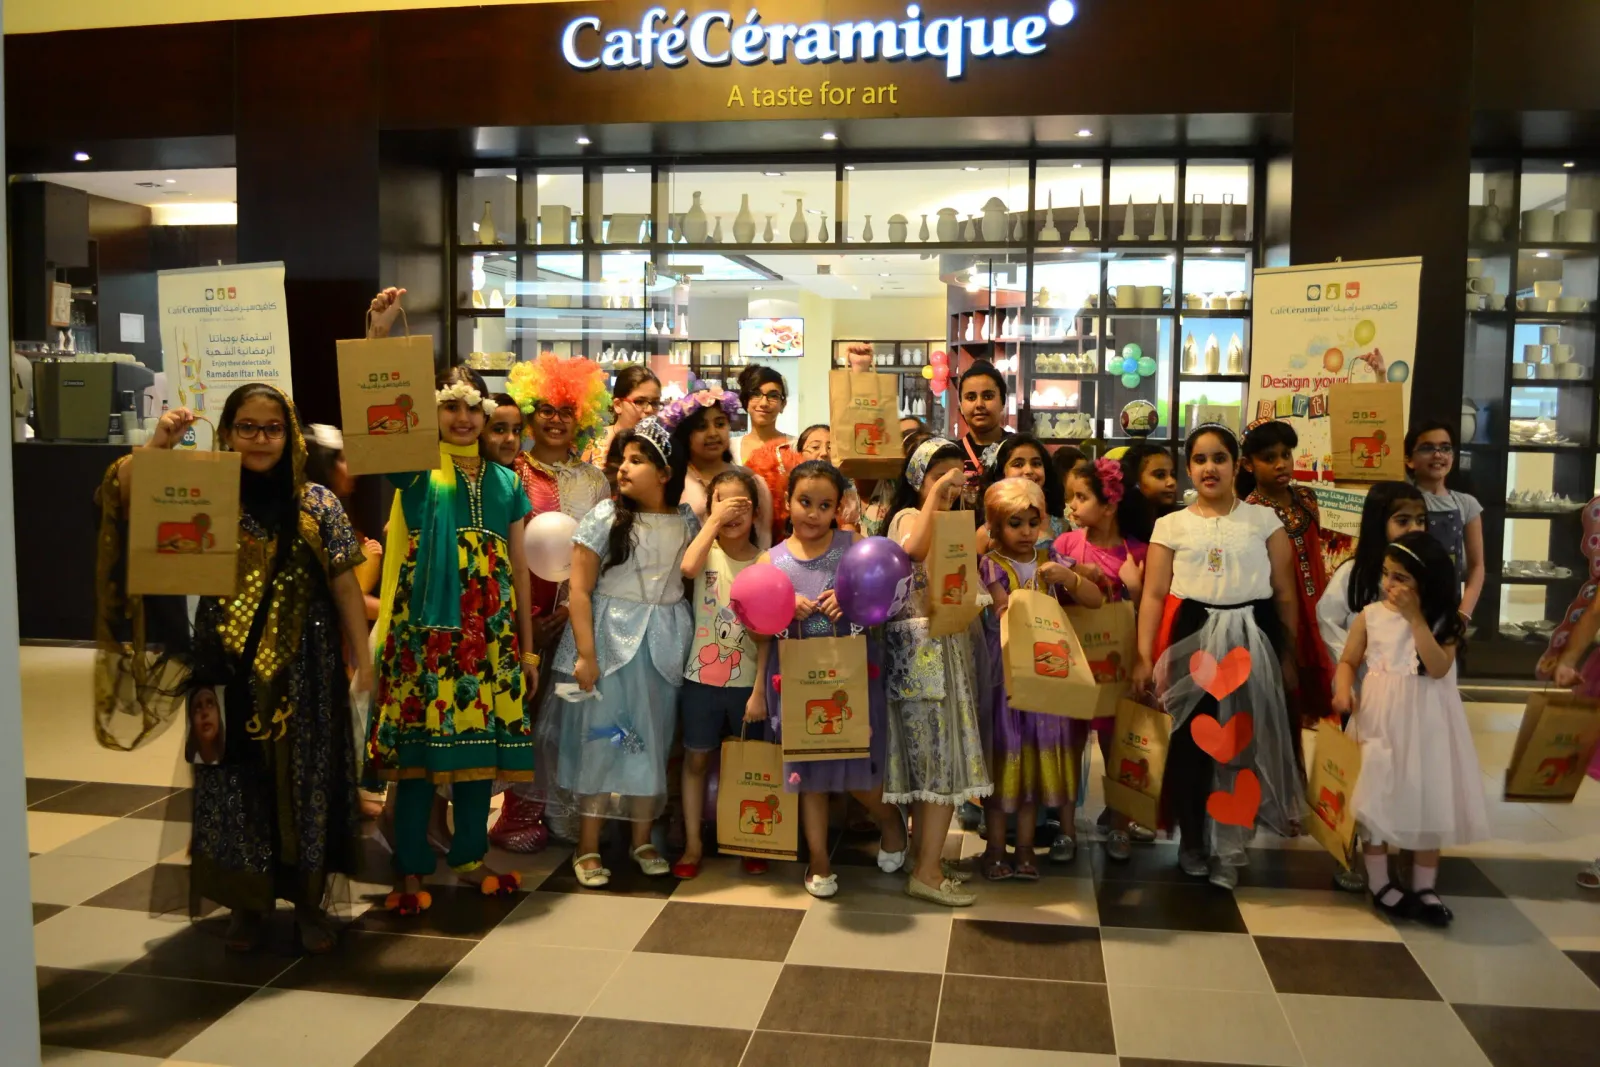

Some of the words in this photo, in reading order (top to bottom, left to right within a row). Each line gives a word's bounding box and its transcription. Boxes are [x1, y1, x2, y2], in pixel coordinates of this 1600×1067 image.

[562, 4, 1048, 78] CaféCéramique
[727, 85, 745, 107] A
[752, 86, 813, 107] taste
[820, 81, 856, 105] for
[862, 83, 898, 104] art
[206, 370, 240, 378] Ramadan
[257, 369, 279, 377] Meals
[1261, 374, 1310, 392] Design
[1261, 396, 1322, 418] Birt
[1339, 502, 1363, 512] birthda
[1331, 521, 1361, 530] Importan
